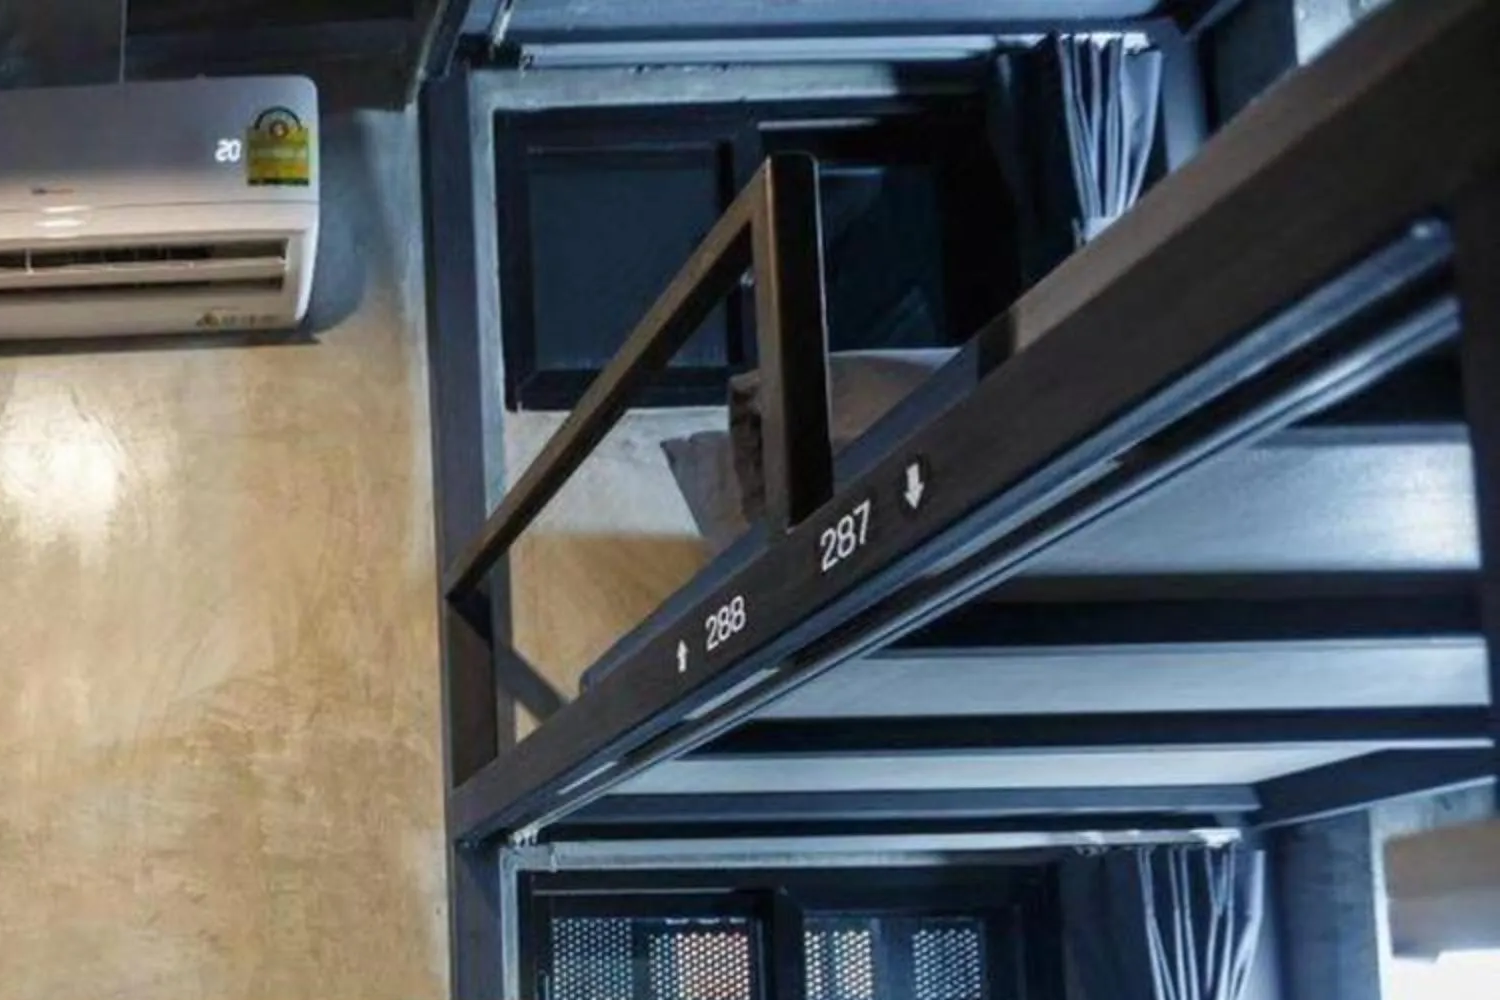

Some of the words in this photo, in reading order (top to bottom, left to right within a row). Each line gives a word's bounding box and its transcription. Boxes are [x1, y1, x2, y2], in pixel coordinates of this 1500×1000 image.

[215, 138, 242, 162] 20
[820, 499, 871, 573] 287
[704, 595, 746, 652] 288
